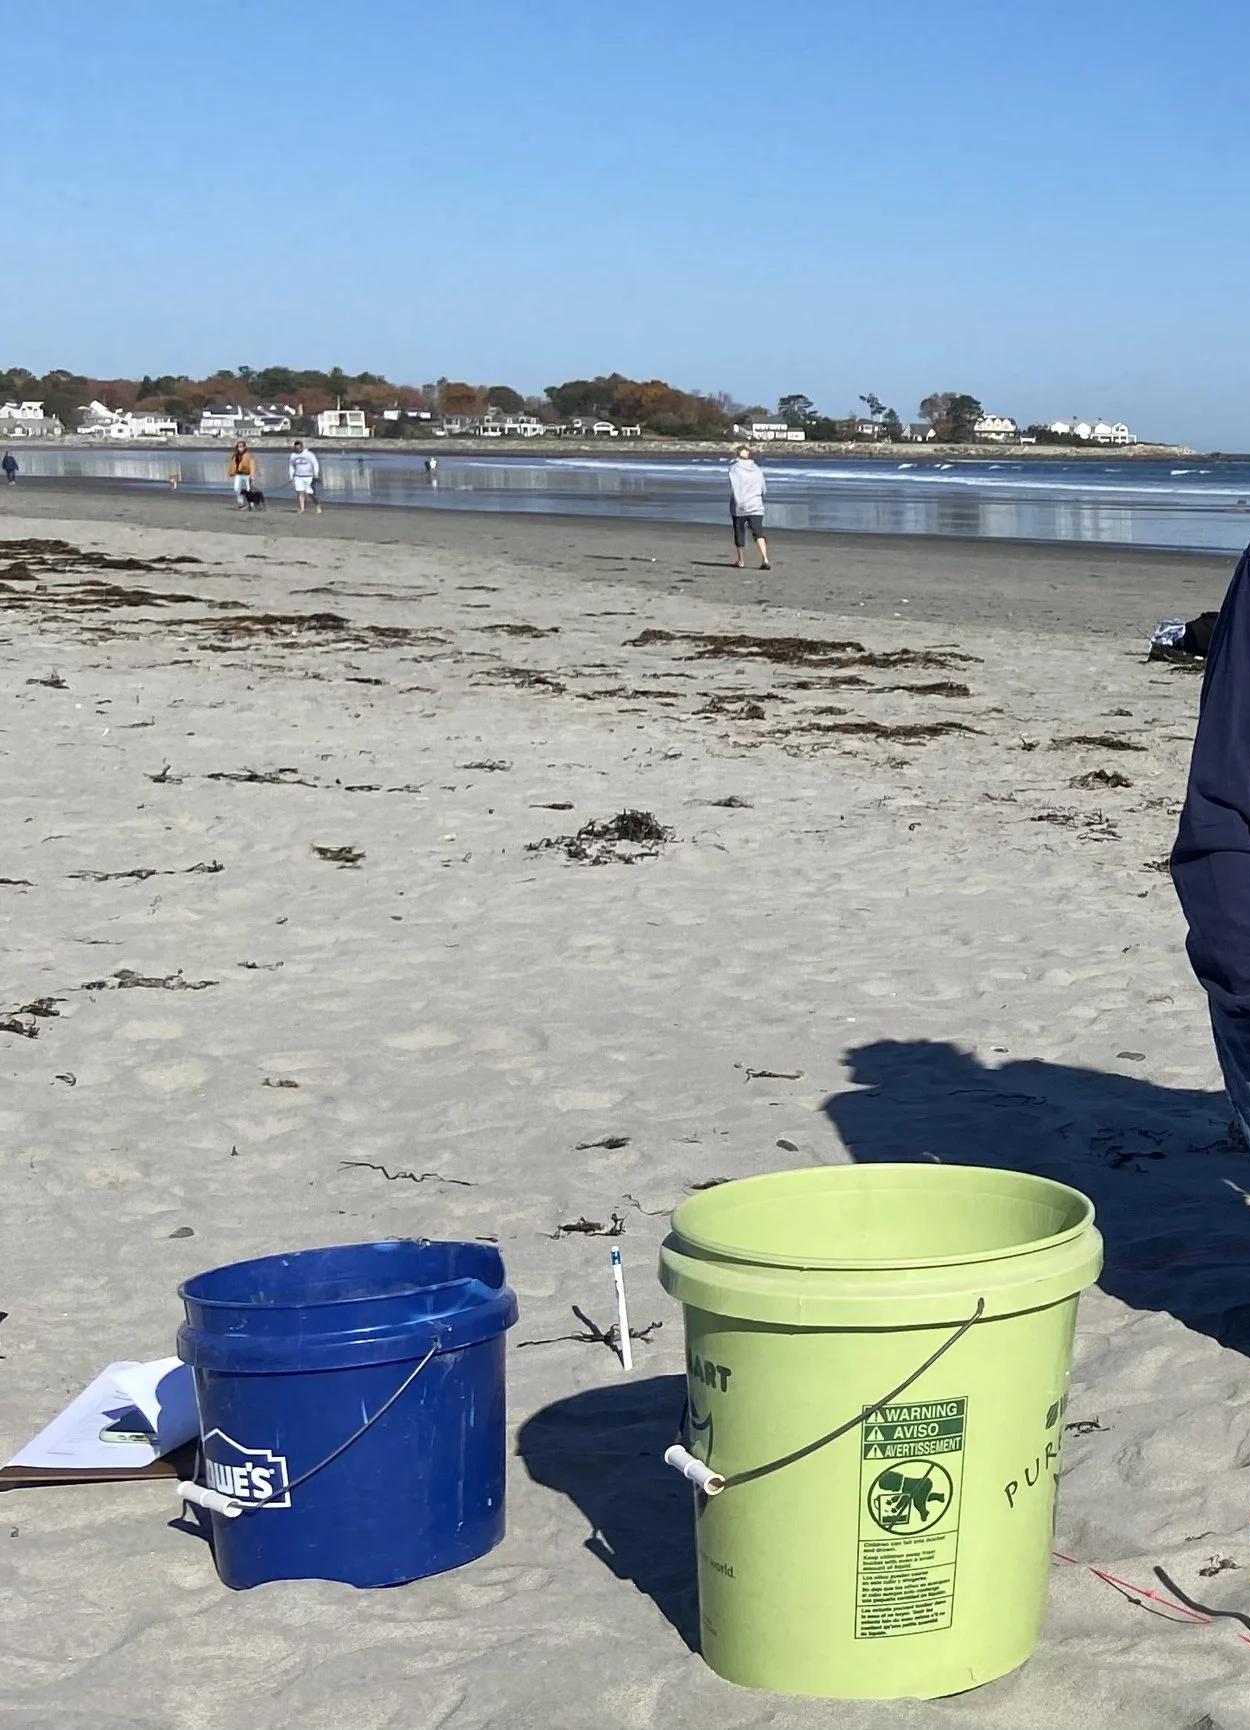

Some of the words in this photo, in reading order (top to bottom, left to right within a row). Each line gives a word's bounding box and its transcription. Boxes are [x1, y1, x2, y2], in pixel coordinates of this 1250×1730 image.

[885, 1402, 958, 1422] WARNING
[893, 1422, 939, 1439] AVISO
[884, 1436, 962, 1457] AVERTISSEMENT
[206, 1458, 273, 1499] OWE'S
